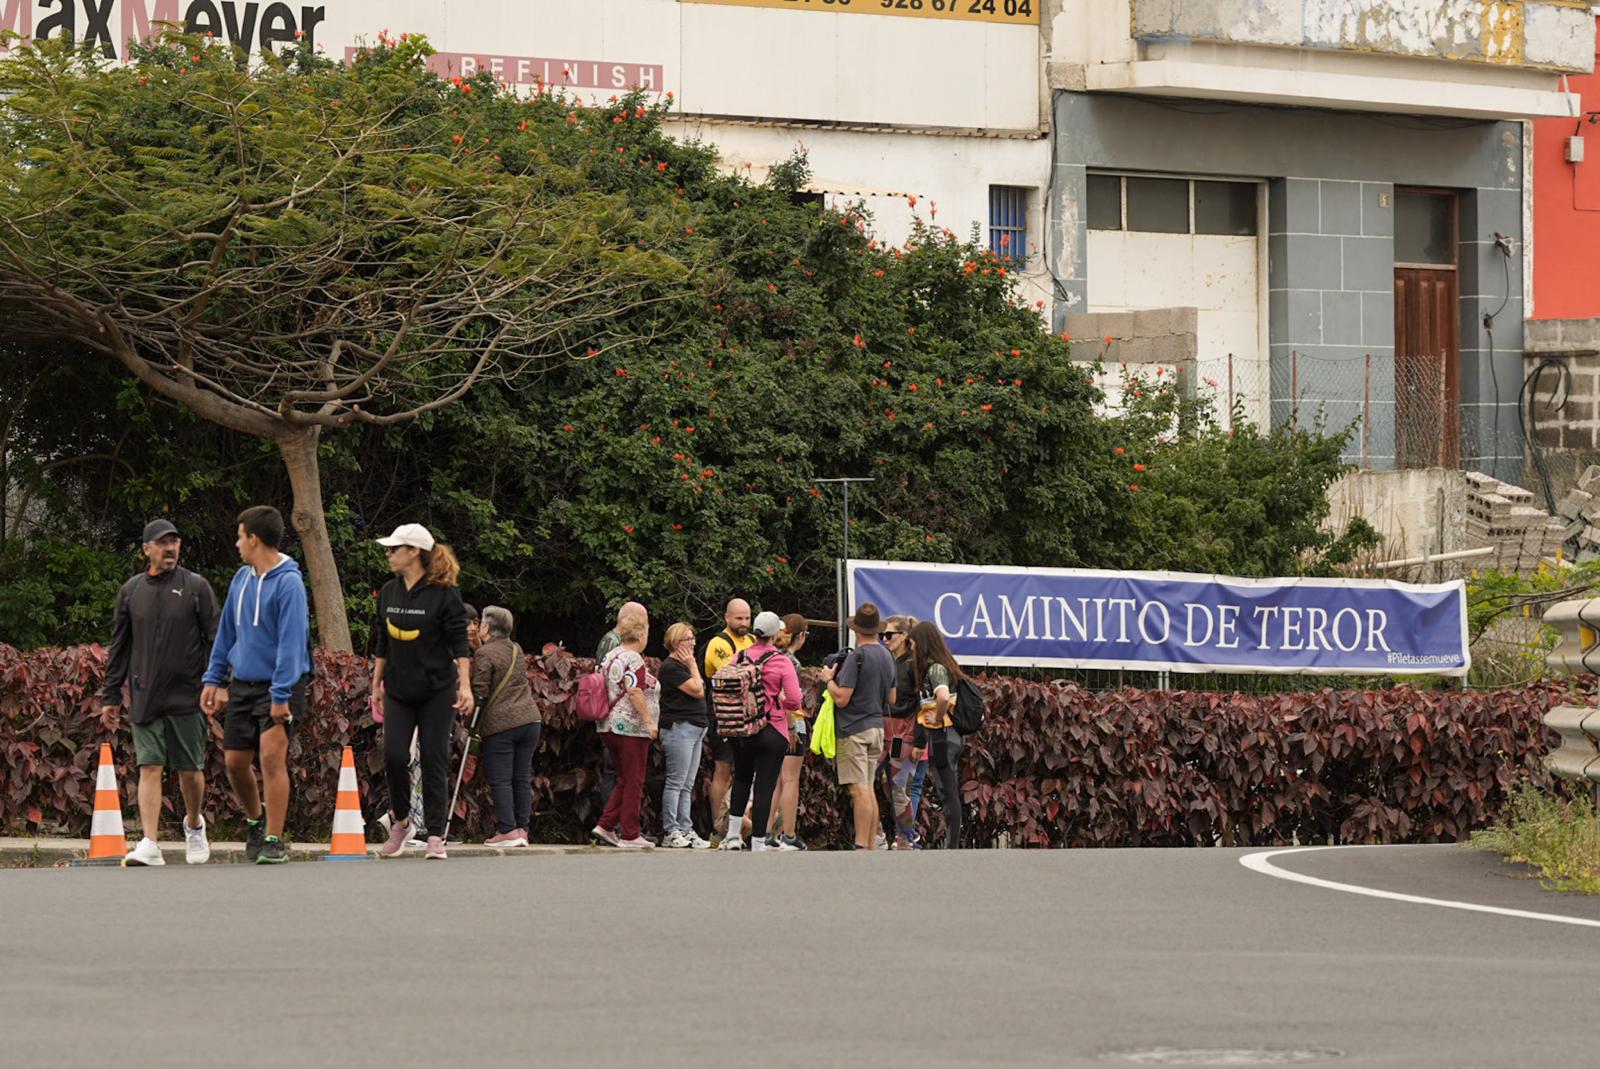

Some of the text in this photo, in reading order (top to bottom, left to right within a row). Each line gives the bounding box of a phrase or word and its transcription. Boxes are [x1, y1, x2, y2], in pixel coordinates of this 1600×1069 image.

[968, 0, 996, 14] 24
[1004, 0, 1032, 17] 04
[461, 56, 655, 89] REFINISH
[934, 592, 1391, 652] CAMINITO DE TEROR
